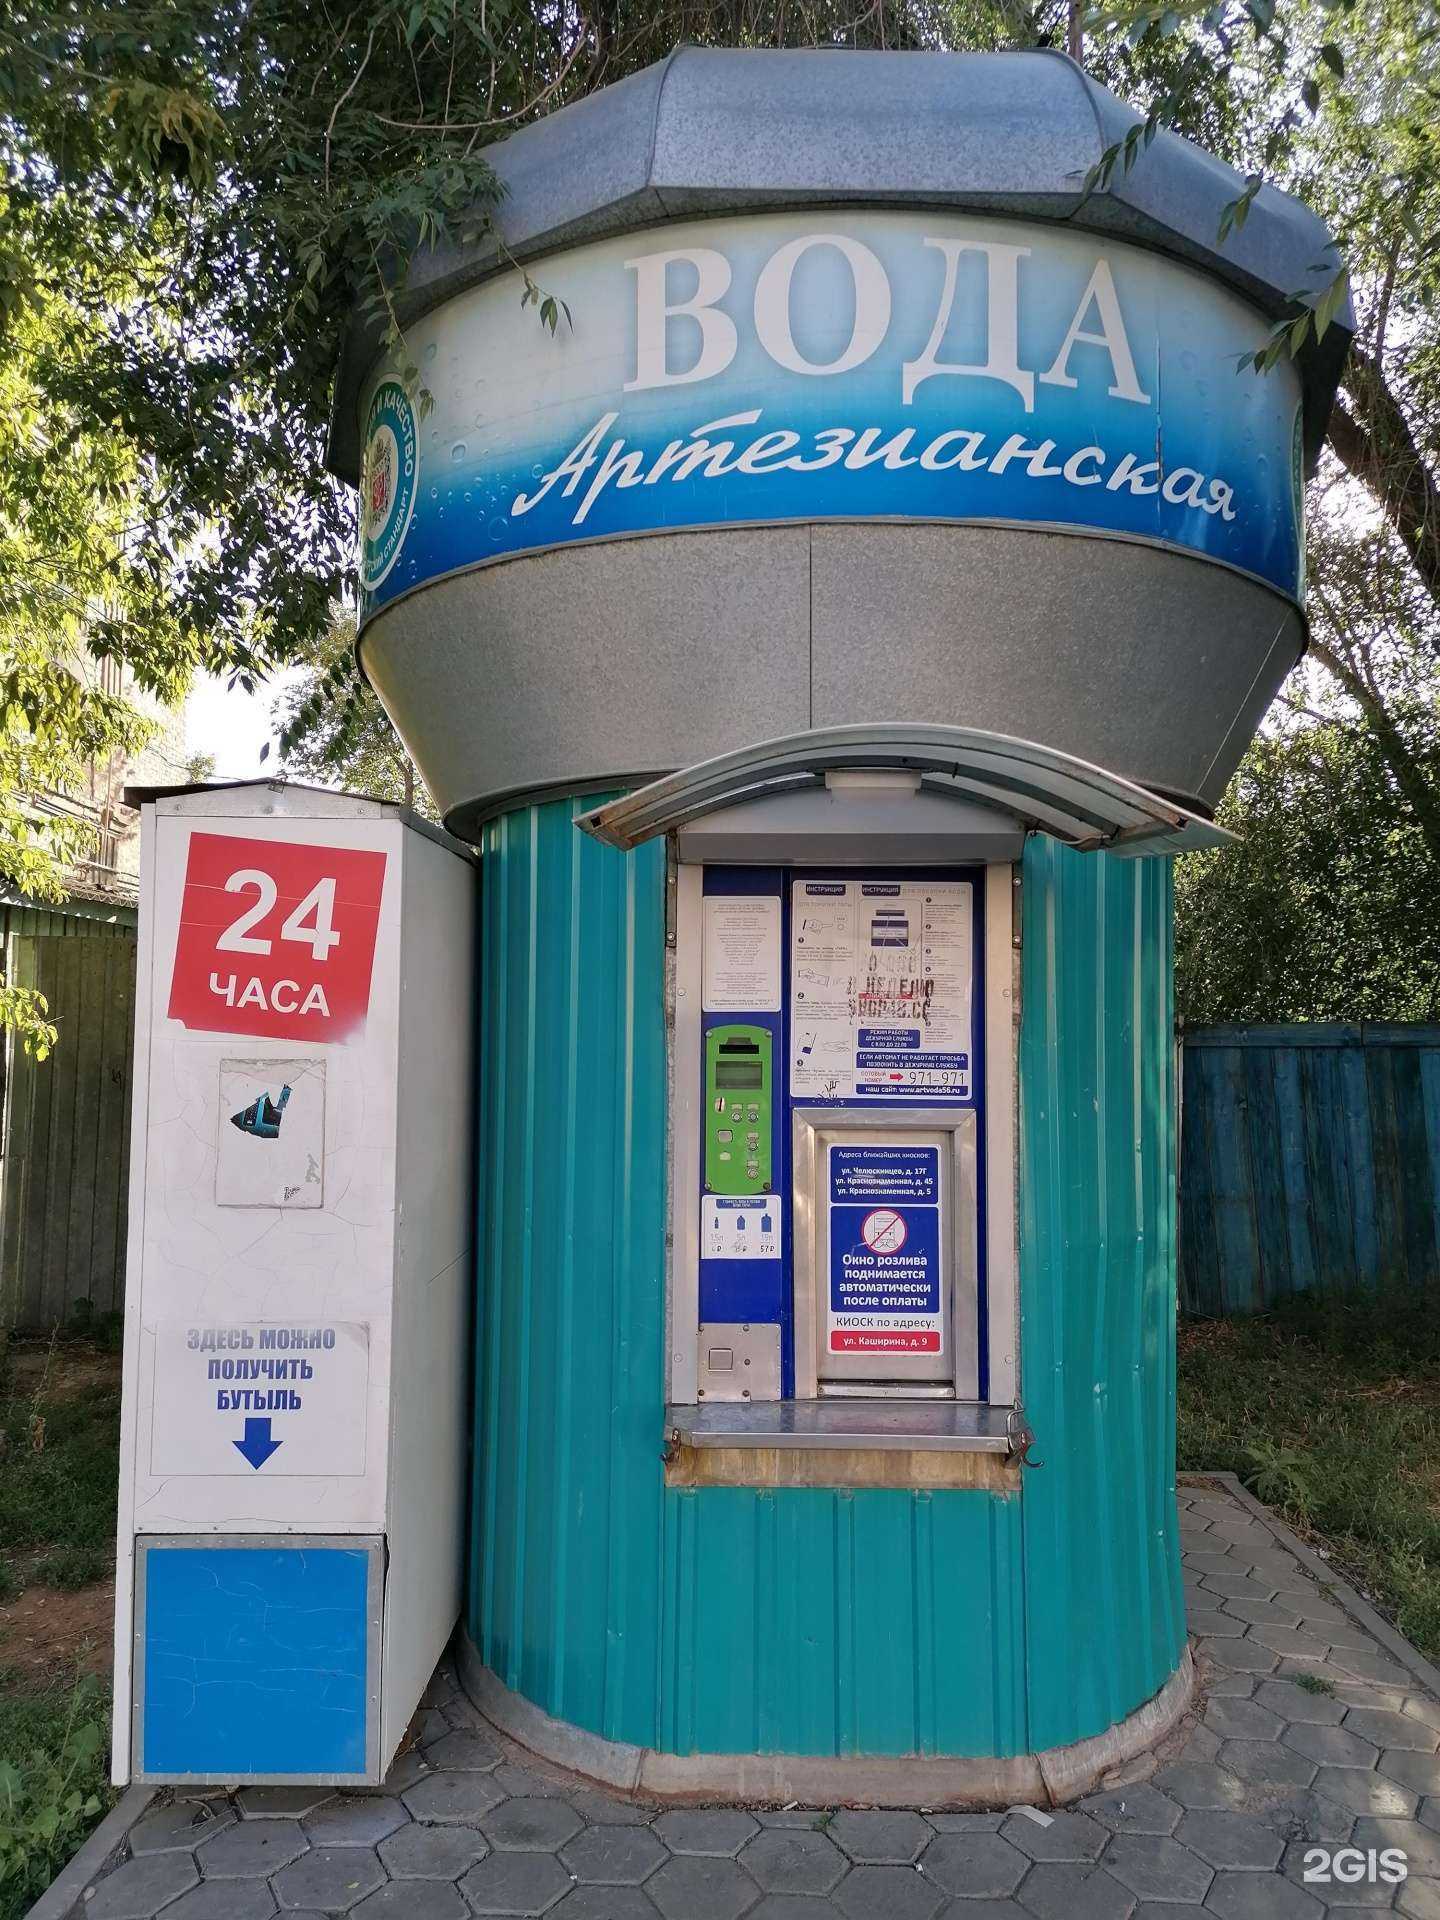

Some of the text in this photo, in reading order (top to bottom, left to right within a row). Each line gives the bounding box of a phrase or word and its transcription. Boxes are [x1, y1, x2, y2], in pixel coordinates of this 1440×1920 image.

[623, 233, 1152, 412] ВОДА
[385, 390, 413, 477] КАЧЕСТВО
[510, 408, 1236, 525] Артезианская
[216, 869, 340, 961] 24
[209, 972, 331, 1017] ЧАСА
[909, 1071, 964, 1085] 971-971
[847, 1178, 914, 1186] Краснознаменная,
[849, 1188, 916, 1197] Краснознаменная,
[842, 1254, 928, 1267] Окно розлива
[845, 1269, 926, 1280] поднимается
[839, 1283, 932, 1293] автоматически
[843, 1297, 928, 1306] после оплаты
[836, 1317, 935, 1329] КИОСК по адресу:
[187, 1328, 336, 1352] ЗДЕСЬ МОЖНО
[843, 1337, 928, 1346] ул. Каширина, д. 9
[207, 1359, 313, 1380] ПОЛУЧИТЬ
[217, 1389, 302, 1411] БУТЫЛЬ
